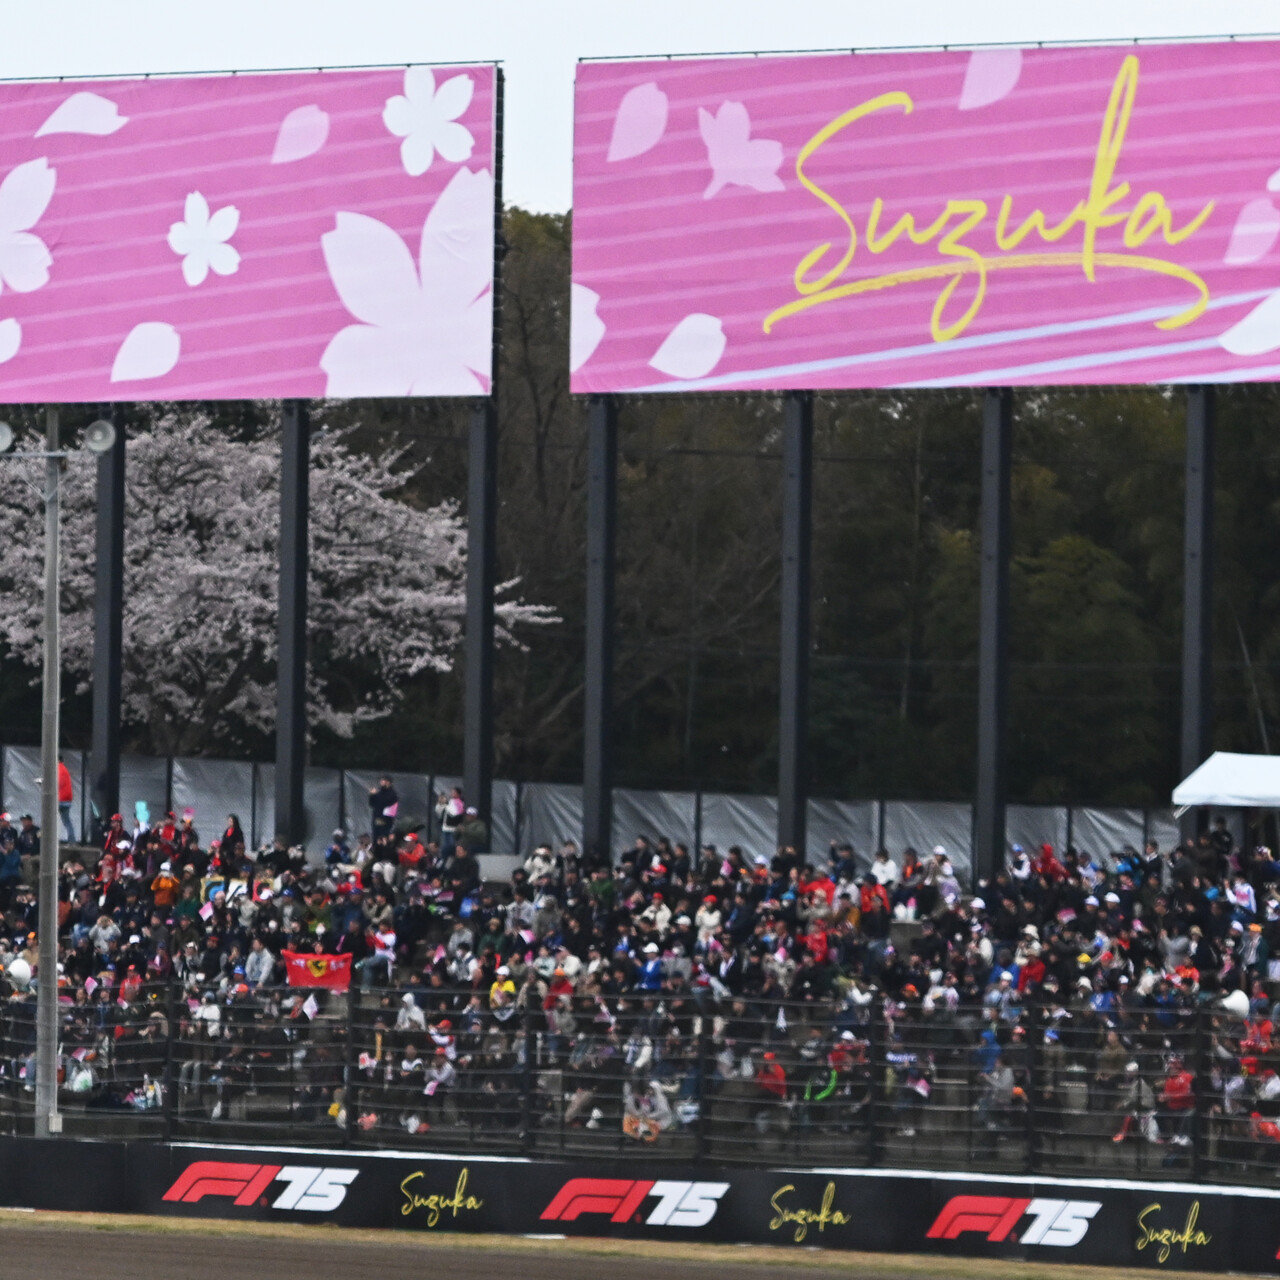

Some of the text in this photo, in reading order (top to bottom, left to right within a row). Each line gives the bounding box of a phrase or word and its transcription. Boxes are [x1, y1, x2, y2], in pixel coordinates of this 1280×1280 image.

[792, 54, 1216, 343] Suzuka
[399, 1166, 484, 1228] Suzuka
[1135, 1199, 1212, 1264] Suzuka
